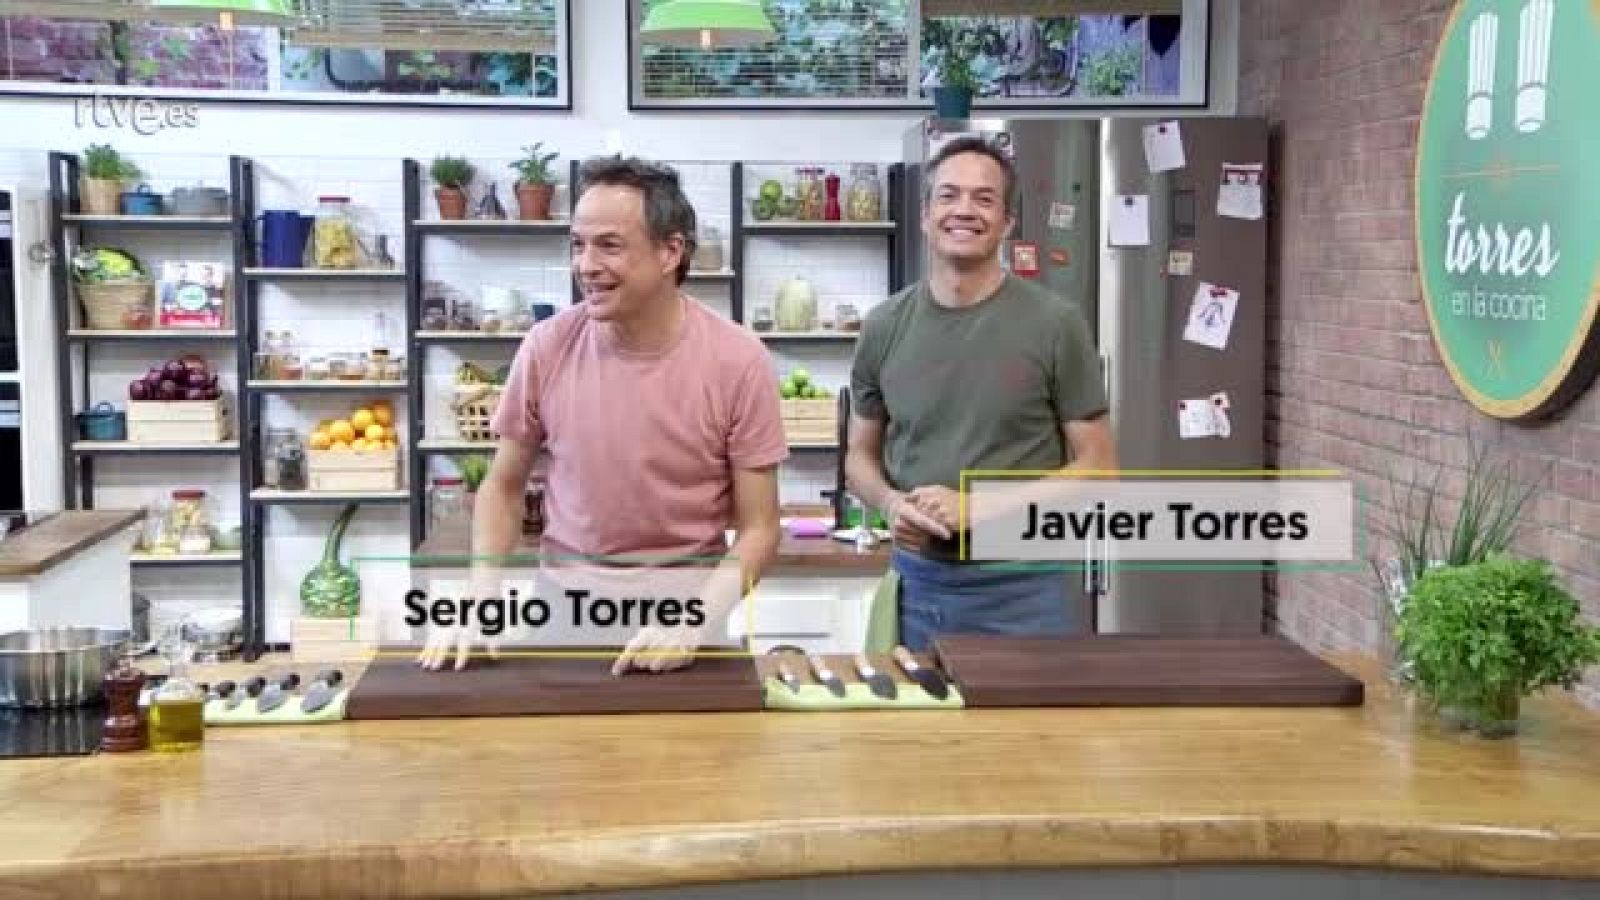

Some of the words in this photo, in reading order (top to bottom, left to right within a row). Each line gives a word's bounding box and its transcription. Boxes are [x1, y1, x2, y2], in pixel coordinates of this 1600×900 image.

[1445, 192, 1560, 276] torres
[1451, 291, 1471, 316] en
[1474, 284, 1487, 318] la
[1489, 287, 1547, 321] cocina
